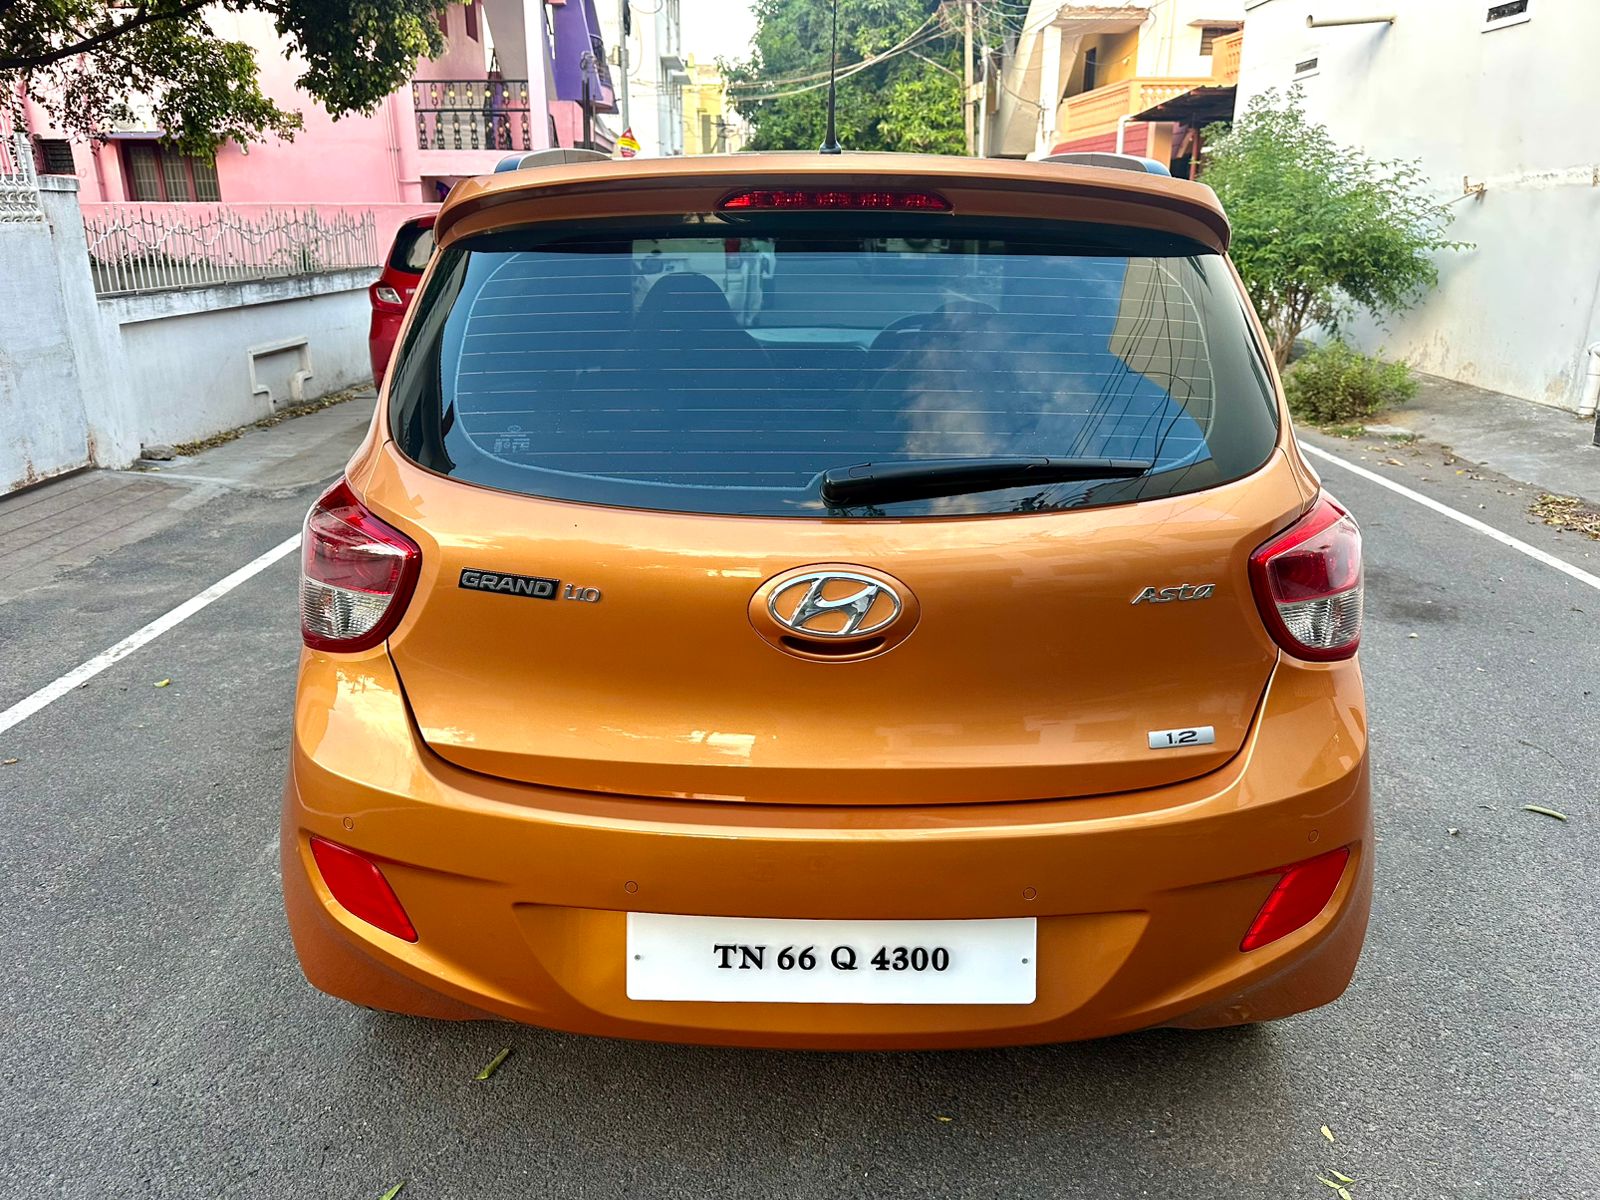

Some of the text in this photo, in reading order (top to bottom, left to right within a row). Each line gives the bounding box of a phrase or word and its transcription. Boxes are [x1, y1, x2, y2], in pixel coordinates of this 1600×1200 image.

[462, 571, 601, 602] GRAND i10
[1130, 583, 1216, 605] Asta
[1166, 730, 1198, 744] 1.2
[714, 945, 949, 971] TN 66 Q 4300
